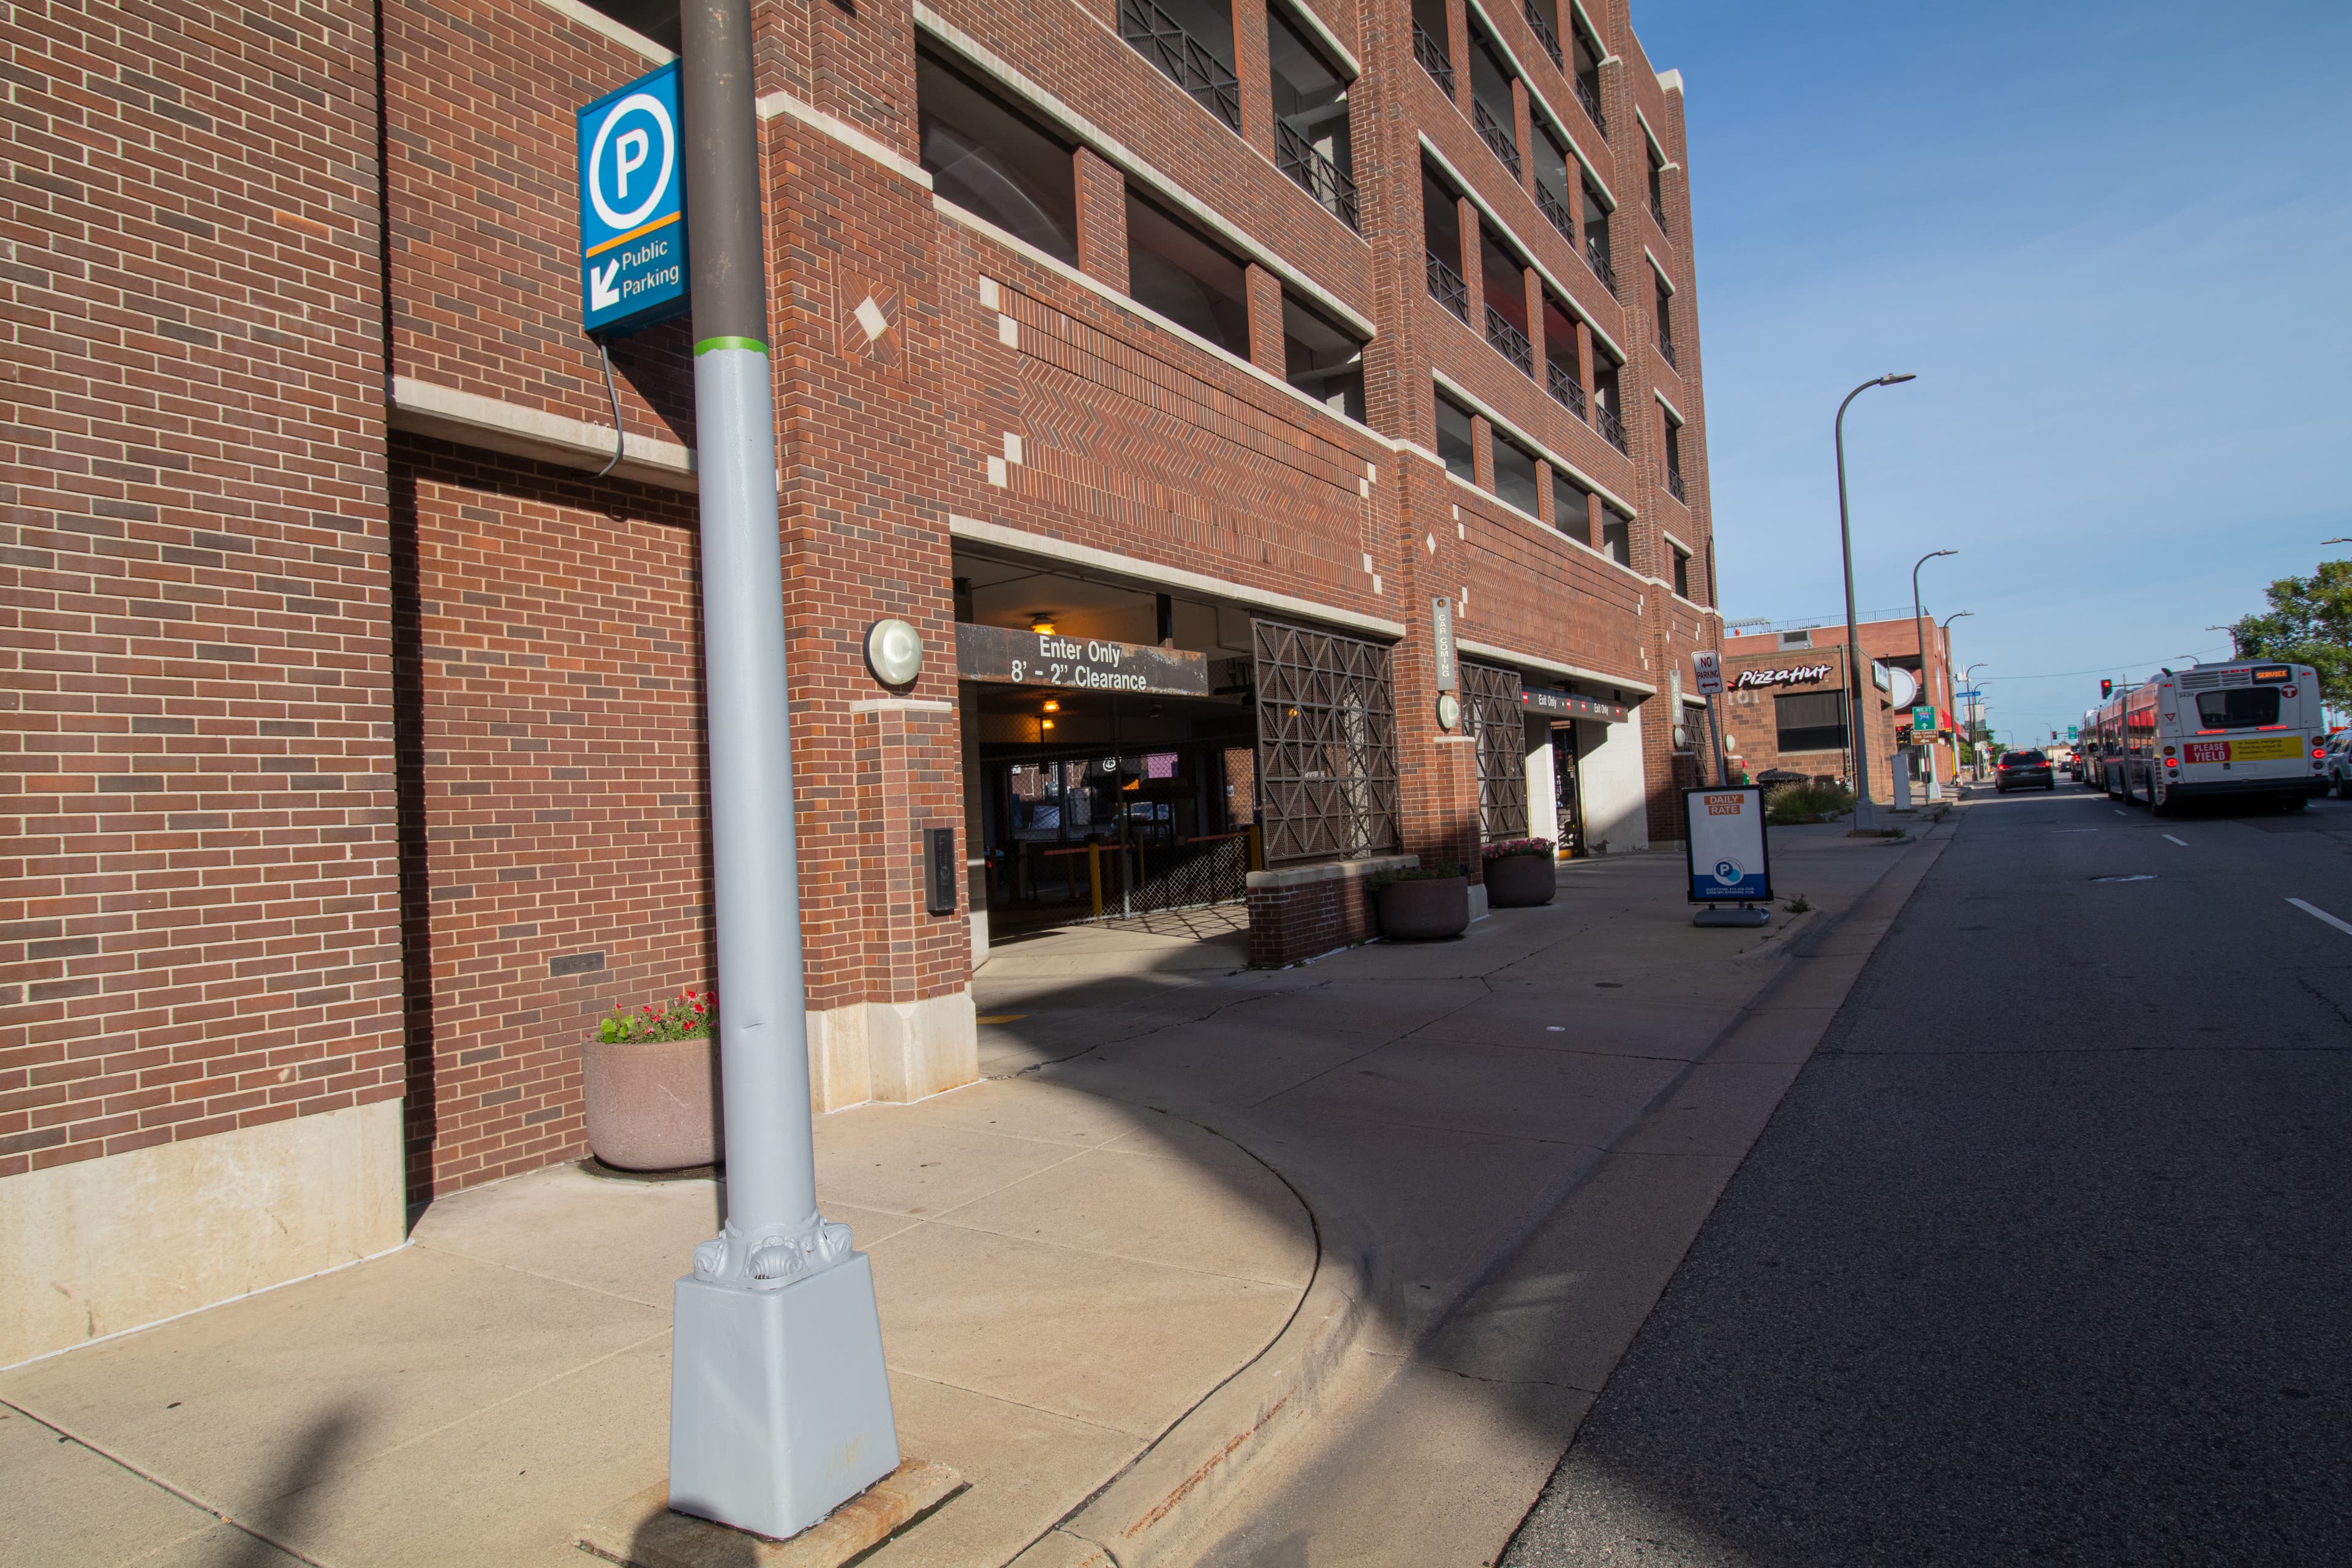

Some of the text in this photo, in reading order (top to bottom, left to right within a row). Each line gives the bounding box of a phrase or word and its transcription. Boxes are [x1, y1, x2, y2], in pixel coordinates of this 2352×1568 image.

[616, 128, 649, 199] P
[622, 239, 668, 271] Public
[623, 263, 679, 298] Parking
[1039, 635, 1120, 668] Enter Only
[1440, 638, 1449, 677] COMING
[1700, 657, 1712, 668] NO
[1075, 665, 1147, 690] Clearance
[1697, 670, 1719, 680] PARKING
[2256, 670, 2287, 679] SERVICE
[1539, 694, 1557, 709] Exit Only
[2193, 743, 2224, 752] PLEASE
[2194, 751, 2225, 761] YIELD
[1710, 796, 1738, 804] DAILY
[1711, 805, 1738, 814] RATE
[1720, 864, 1730, 875] P
